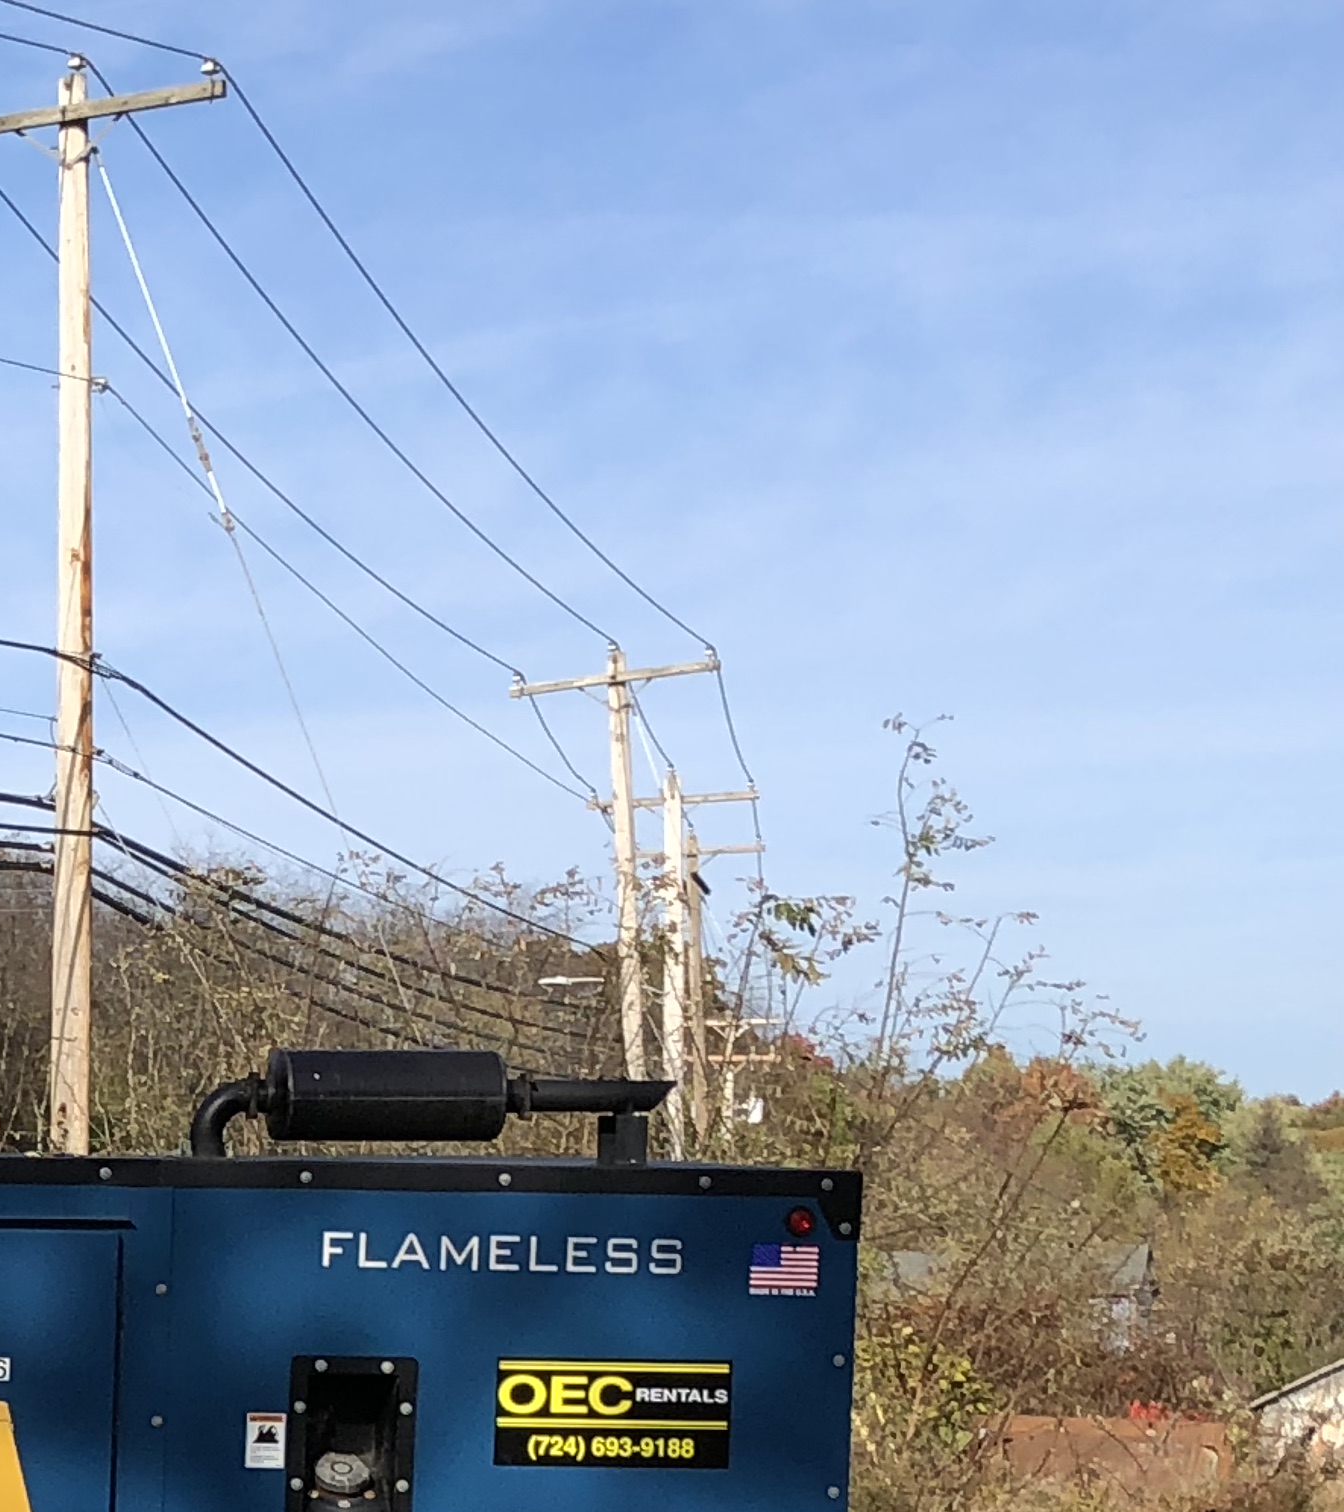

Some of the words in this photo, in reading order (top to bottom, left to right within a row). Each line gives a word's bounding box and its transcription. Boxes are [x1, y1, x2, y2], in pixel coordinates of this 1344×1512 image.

[321, 1231, 683, 1275] FLAMELESS
[498, 1373, 634, 1416] OEC
[635, 1387, 729, 1404] RENTALS
[527, 1434, 586, 1462] (724)
[590, 1436, 696, 1459] 693-9188
